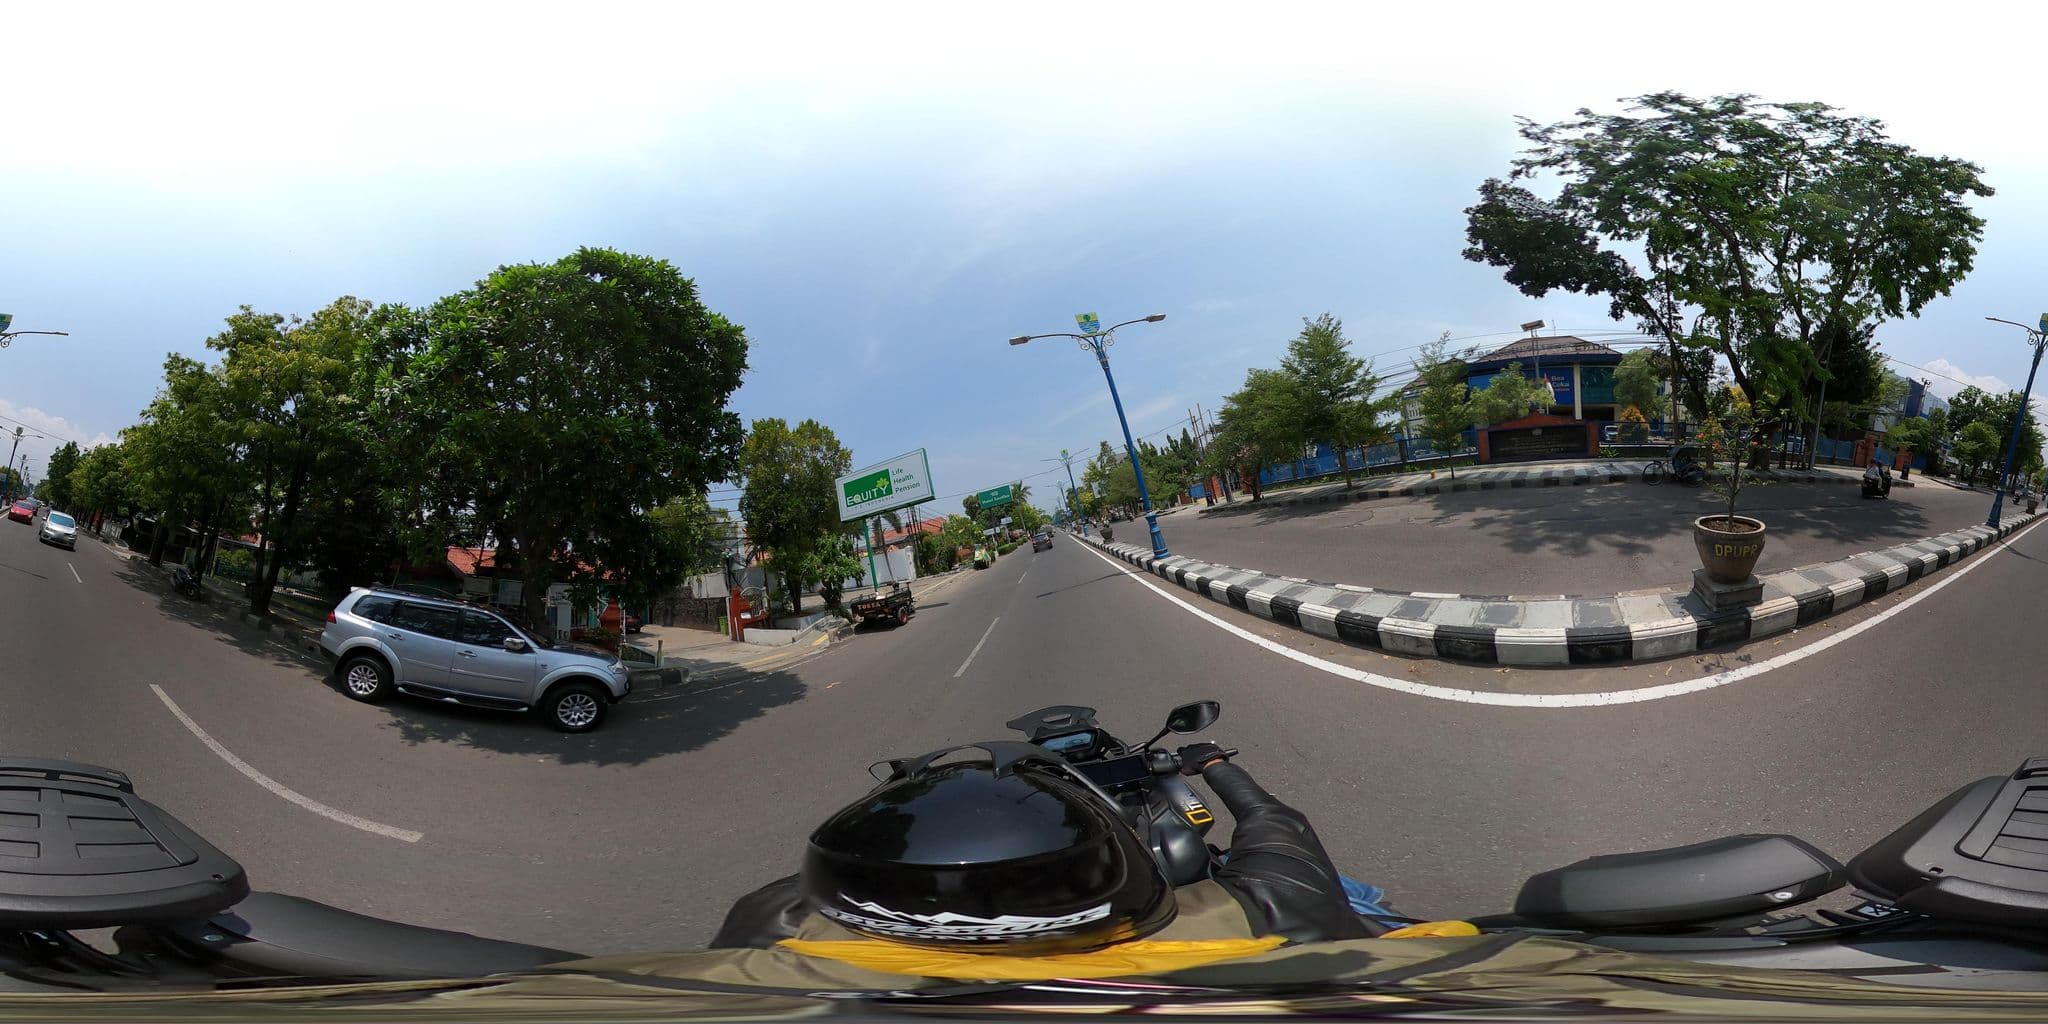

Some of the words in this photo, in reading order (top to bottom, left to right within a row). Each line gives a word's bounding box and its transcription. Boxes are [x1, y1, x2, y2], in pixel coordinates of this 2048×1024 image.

[892, 468, 904, 476] Life
[893, 473, 914, 485] Health
[895, 481, 921, 493] Pension
[846, 486, 888, 506] EQUITY
[1715, 543, 1758, 557] DPUPR
